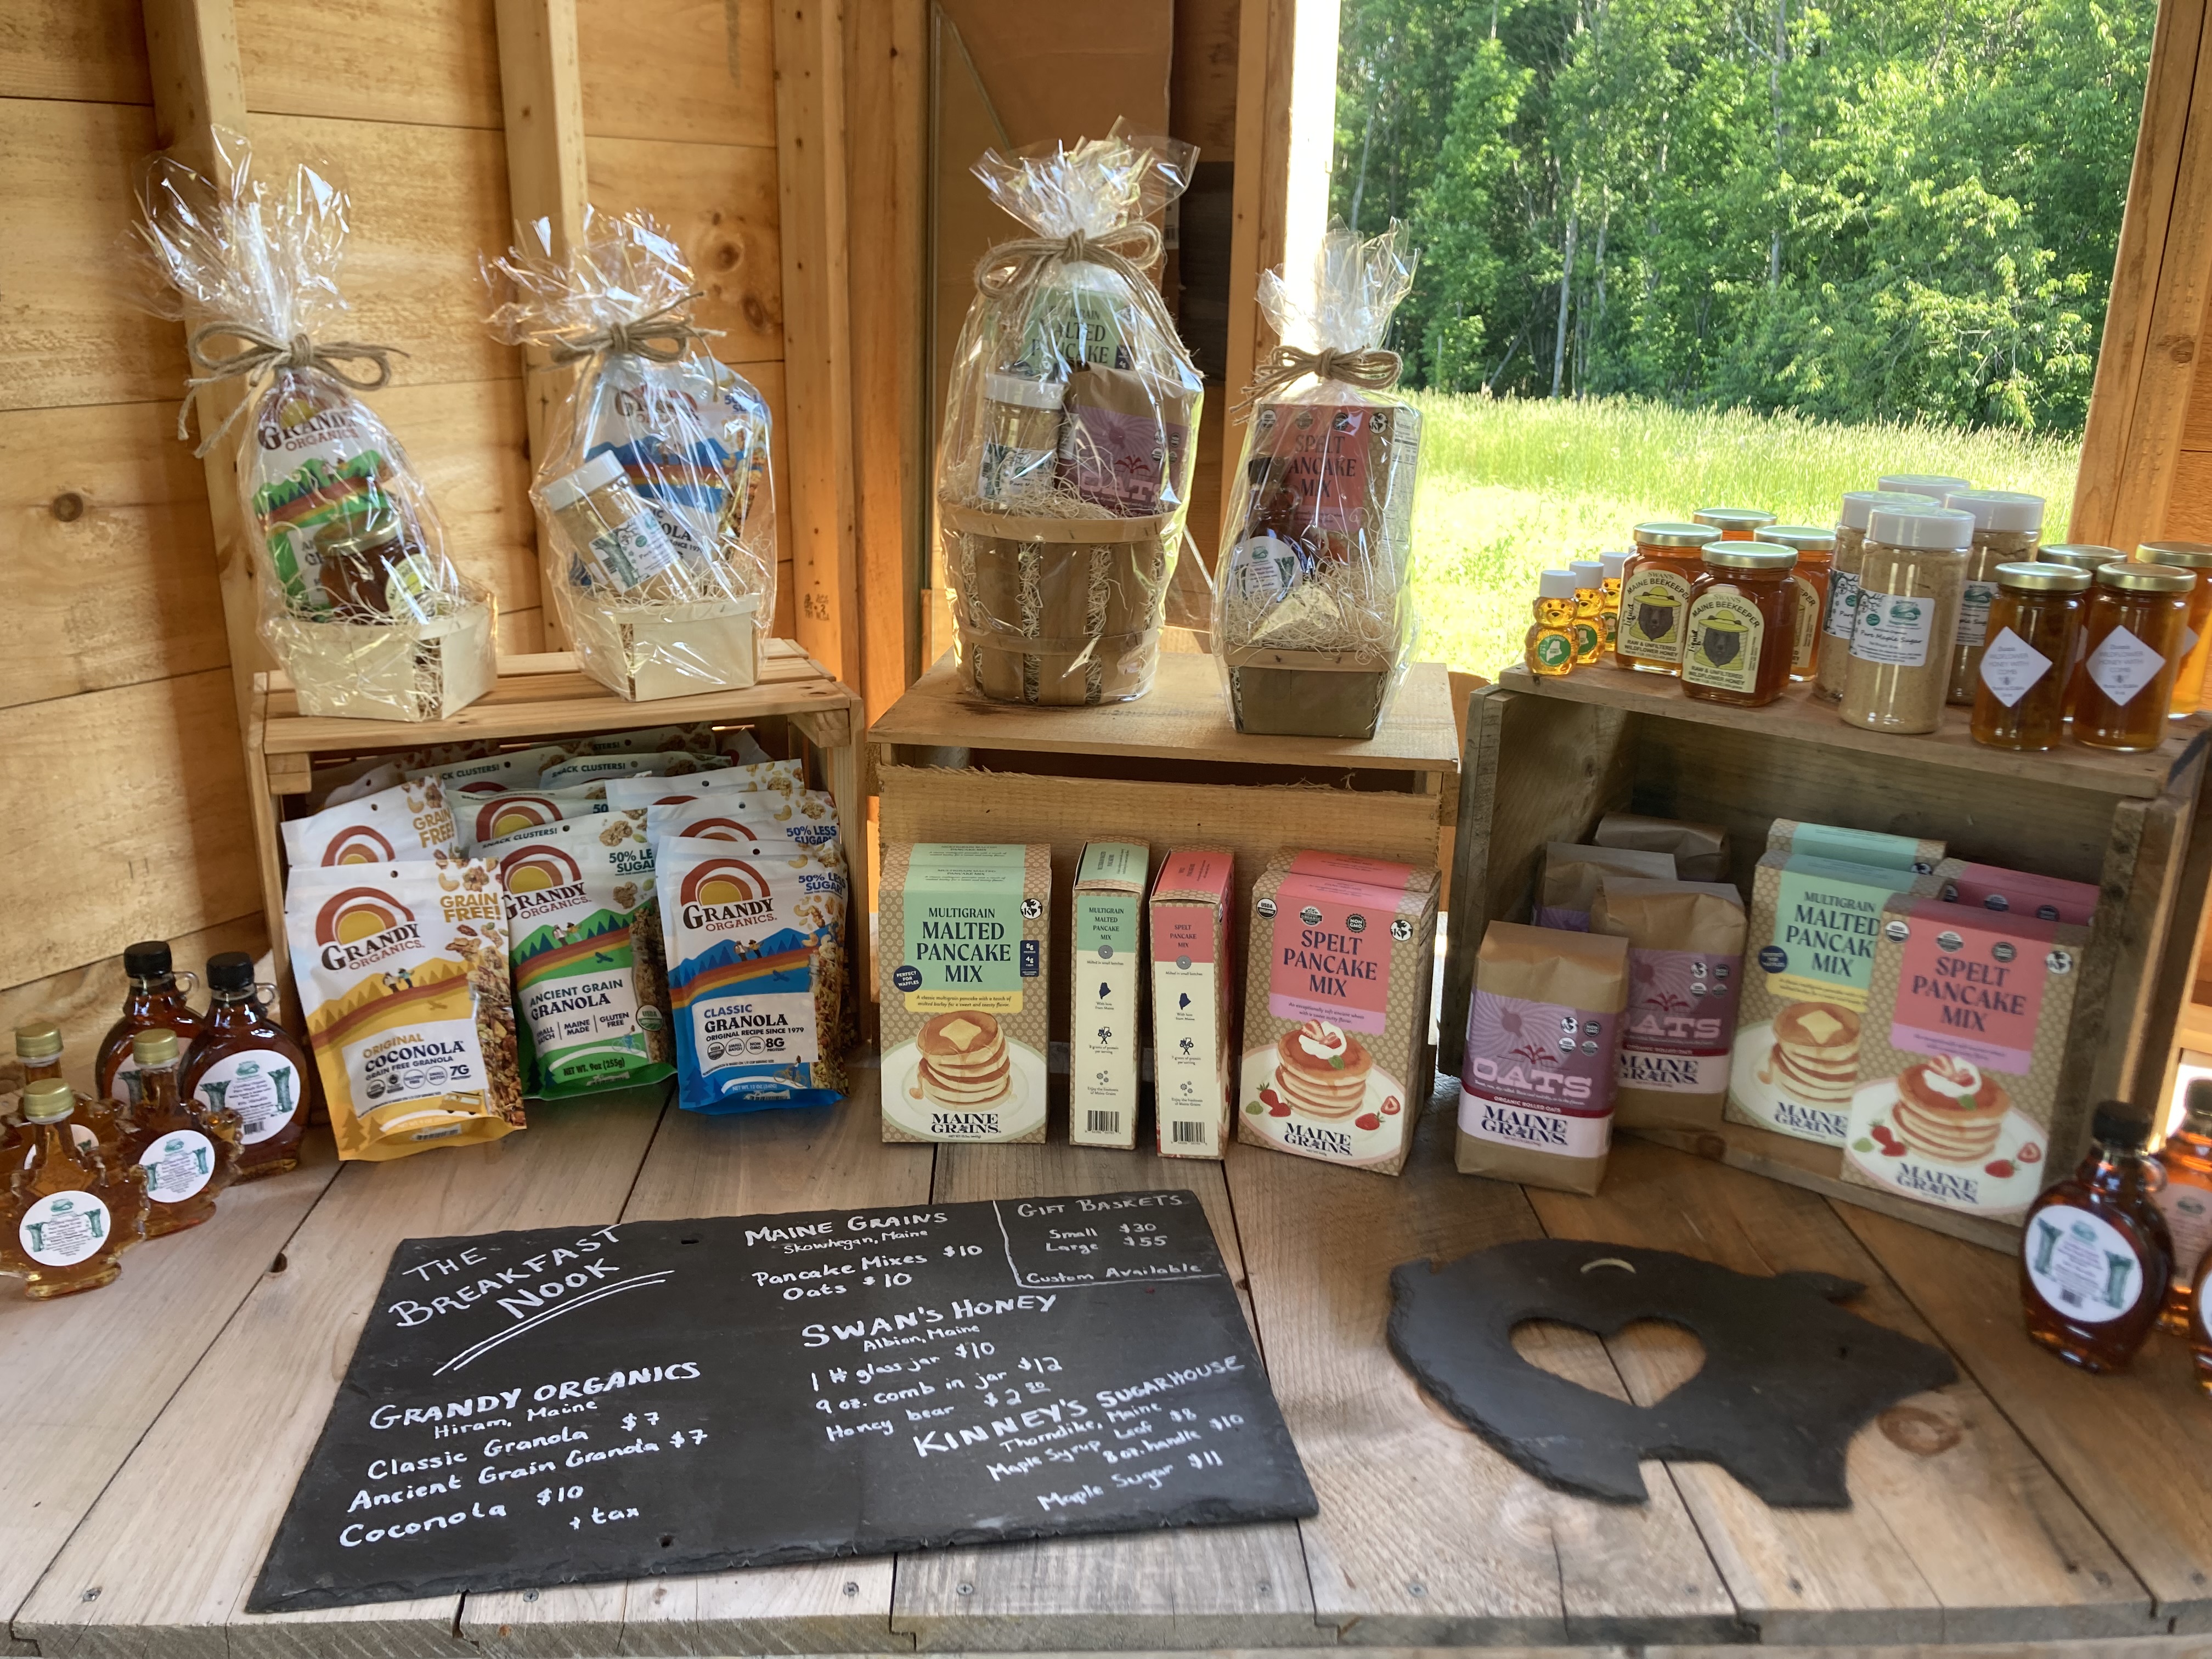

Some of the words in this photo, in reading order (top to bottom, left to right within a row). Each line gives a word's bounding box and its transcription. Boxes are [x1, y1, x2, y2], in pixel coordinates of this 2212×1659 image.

[1295, 435, 1345, 454] SPELT
[1289, 456, 1356, 477] ANCAKE
[1301, 479, 1331, 498] MIX
[1627, 578, 1648, 595] MAINE
[1692, 602, 1714, 618] MAINE
[1716, 601, 1760, 628] BEEKEEPER
[1624, 645, 1658, 654] WILDFLOWER
[1645, 642, 1677, 651] UNFILTERED
[1875, 634, 1899, 642] Maple
[512, 827, 557, 841] CLUSTERS!
[798, 874, 825, 884] 50%
[827, 872, 846, 888] LESS
[440, 893, 498, 907] GRAIN
[521, 896, 592, 919] ORGANICS
[928, 907, 996, 918] MULTIGRAIN
[1804, 891, 1876, 913] MULTIGRAIN
[444, 906, 501, 923] FREE!
[682, 898, 774, 930] GRANDY
[705, 913, 777, 932] ORGANICS
[1794, 904, 1881, 936] MALTED
[922, 921, 1005, 940] MALTED
[1301, 929, 1363, 956] SPELT
[1786, 924, 1876, 958] PANCAK
[321, 923, 421, 971] GRANDY
[349, 939, 425, 970] ORGANICS
[917, 943, 1011, 962] PANCAKE
[945, 964, 983, 983] MIX
[1283, 947, 1378, 981] PANCAKE
[1812, 952, 1854, 978] MIX
[1936, 956, 2010, 988] SPELT
[529, 986, 578, 1008] ANCIENT
[582, 979, 623, 994] GRAIN
[1310, 974, 1347, 997] MIX
[1911, 974, 2027, 1015] PANCAKE
[531, 992, 611, 1021] GRANOLA
[599, 1012, 629, 1023] GLUTEN
[704, 1004, 753, 1019] CLASSIC
[1940, 1005, 1987, 1032] MIX
[563, 1019, 590, 1030] MAINE
[566, 1025, 590, 1036] MADE
[607, 1019, 624, 1028] FREE
[704, 1013, 788, 1034] GRANOLA
[706, 1031, 740, 1042] ORIGINAL
[741, 1029, 764, 1037] RECIPE
[765, 1027, 786, 1035] SINCE
[363, 1033, 424, 1059] ORIGINAL
[765, 1037, 785, 1048] 8G
[364, 1041, 465, 1072] COCONOLA
[366, 1068, 390, 1081] GRAIN
[392, 1062, 411, 1073] FREE
[413, 1056, 453, 1066] GRANOLA
[449, 1064, 470, 1076] 7G
[1473, 1057, 1592, 1099] OATS
[931, 1113, 998, 1124] MAINE
[931, 1124, 998, 1133] GRAINS
[1482, 1104, 1567, 1133] MAINE
[1284, 1133, 1351, 1156] GRAINS
[1285, 1122, 1351, 1146] MAINE
[1481, 1119, 1568, 1146] GRAINS
[1017, 1204, 1065, 1217] GIFT
[1076, 1195, 1182, 1211] BASKETS
[744, 1222, 833, 1247] MAINE
[847, 1212, 948, 1233] GRAINS
[783, 1237, 878, 1254] Skowhegan,
[881, 1230, 928, 1242] Maine
[1049, 1227, 1098, 1239] Small
[1119, 1223, 1157, 1233] $30
[1046, 1242, 1099, 1255] Large
[1123, 1235, 1167, 1247] $55
[388, 1223, 621, 1327] BREAKFAST
[402, 1247, 487, 1281] THE
[751, 1264, 856, 1287] Pancake
[861, 1255, 928, 1271] Mixes
[943, 1245, 983, 1257] $10
[1026, 1272, 1094, 1283] Custom
[1105, 1263, 1201, 1278] Available
[495, 1259, 620, 1319] NOOK
[783, 1283, 847, 1301] Oats
[862, 1272, 912, 1288] $10
[802, 1306, 945, 1347] SWAN'S
[951, 1294, 1056, 1319] HONEY
[864, 1335, 927, 1352] Albion,
[926, 1325, 980, 1340] Maine
[856, 1362, 902, 1384] glass
[907, 1356, 940, 1372] jar
[955, 1342, 995, 1359] $10
[369, 1387, 522, 1429] GRANDY
[533, 1362, 701, 1402] ORGANICS
[815, 1398, 833, 1414] 9
[838, 1398, 867, 1410] oz.
[873, 1381, 935, 1404] comb
[945, 1378, 966, 1390] in
[974, 1372, 1007, 1390] jar
[1018, 1356, 1063, 1374] $12
[913, 1398, 1090, 1457] KINNEY'S
[1096, 1355, 1245, 1408] SUGARHOUSE
[435, 1419, 512, 1440] Hiram,
[527, 1401, 598, 1422] Maine
[826, 1420, 894, 1442] Honey
[905, 1406, 955, 1421] bear
[998, 1420, 1103, 1453] Thorndike,
[1106, 1403, 1162, 1423] Maine
[367, 1451, 468, 1480] Classic
[483, 1426, 589, 1457] Granola
[620, 1411, 660, 1432] $7
[986, 1456, 1042, 1482] Maple
[1044, 1441, 1101, 1462] Syrup
[1169, 1408, 1197, 1422] $8
[1102, 1450, 1119, 1464] 8
[1120, 1447, 1145, 1459] oz.
[1139, 1430, 1201, 1455] handle
[1209, 1414, 1244, 1431] $10
[347, 1474, 462, 1513] Ancient
[478, 1461, 556, 1485] Grain
[565, 1438, 660, 1468] Granola
[669, 1429, 708, 1449] $7
[1037, 1485, 1104, 1511] Maple
[1111, 1464, 1173, 1490] Sugar
[1187, 1450, 1223, 1470] $11
[339, 1502, 507, 1547] Coconola
[537, 1485, 584, 1506] $10
[591, 1506, 640, 1524] tax
